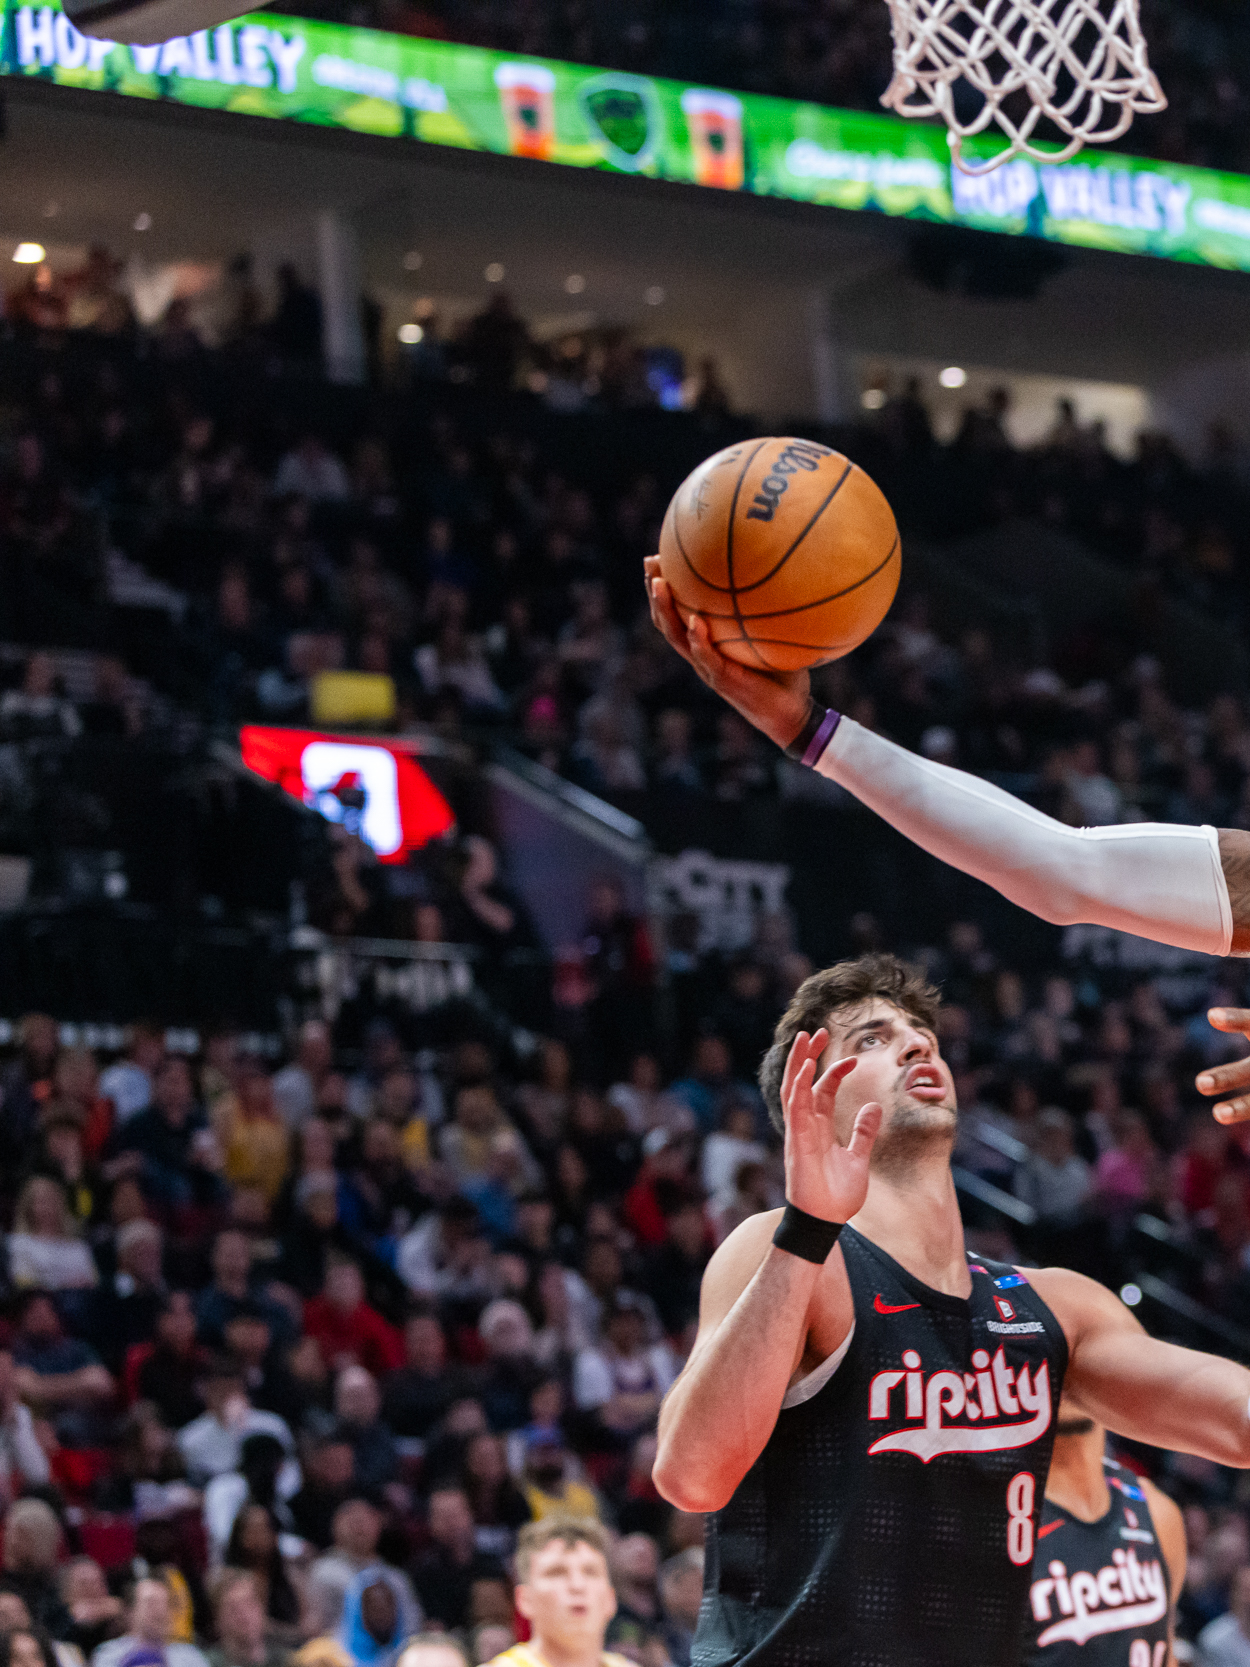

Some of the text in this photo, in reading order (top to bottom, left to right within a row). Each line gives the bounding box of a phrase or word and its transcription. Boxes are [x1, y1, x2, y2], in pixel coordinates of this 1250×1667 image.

[867, 1343, 1053, 1464] ripcity
[1006, 1471, 1036, 1566] 8
[1029, 1547, 1168, 1648] ripcity
